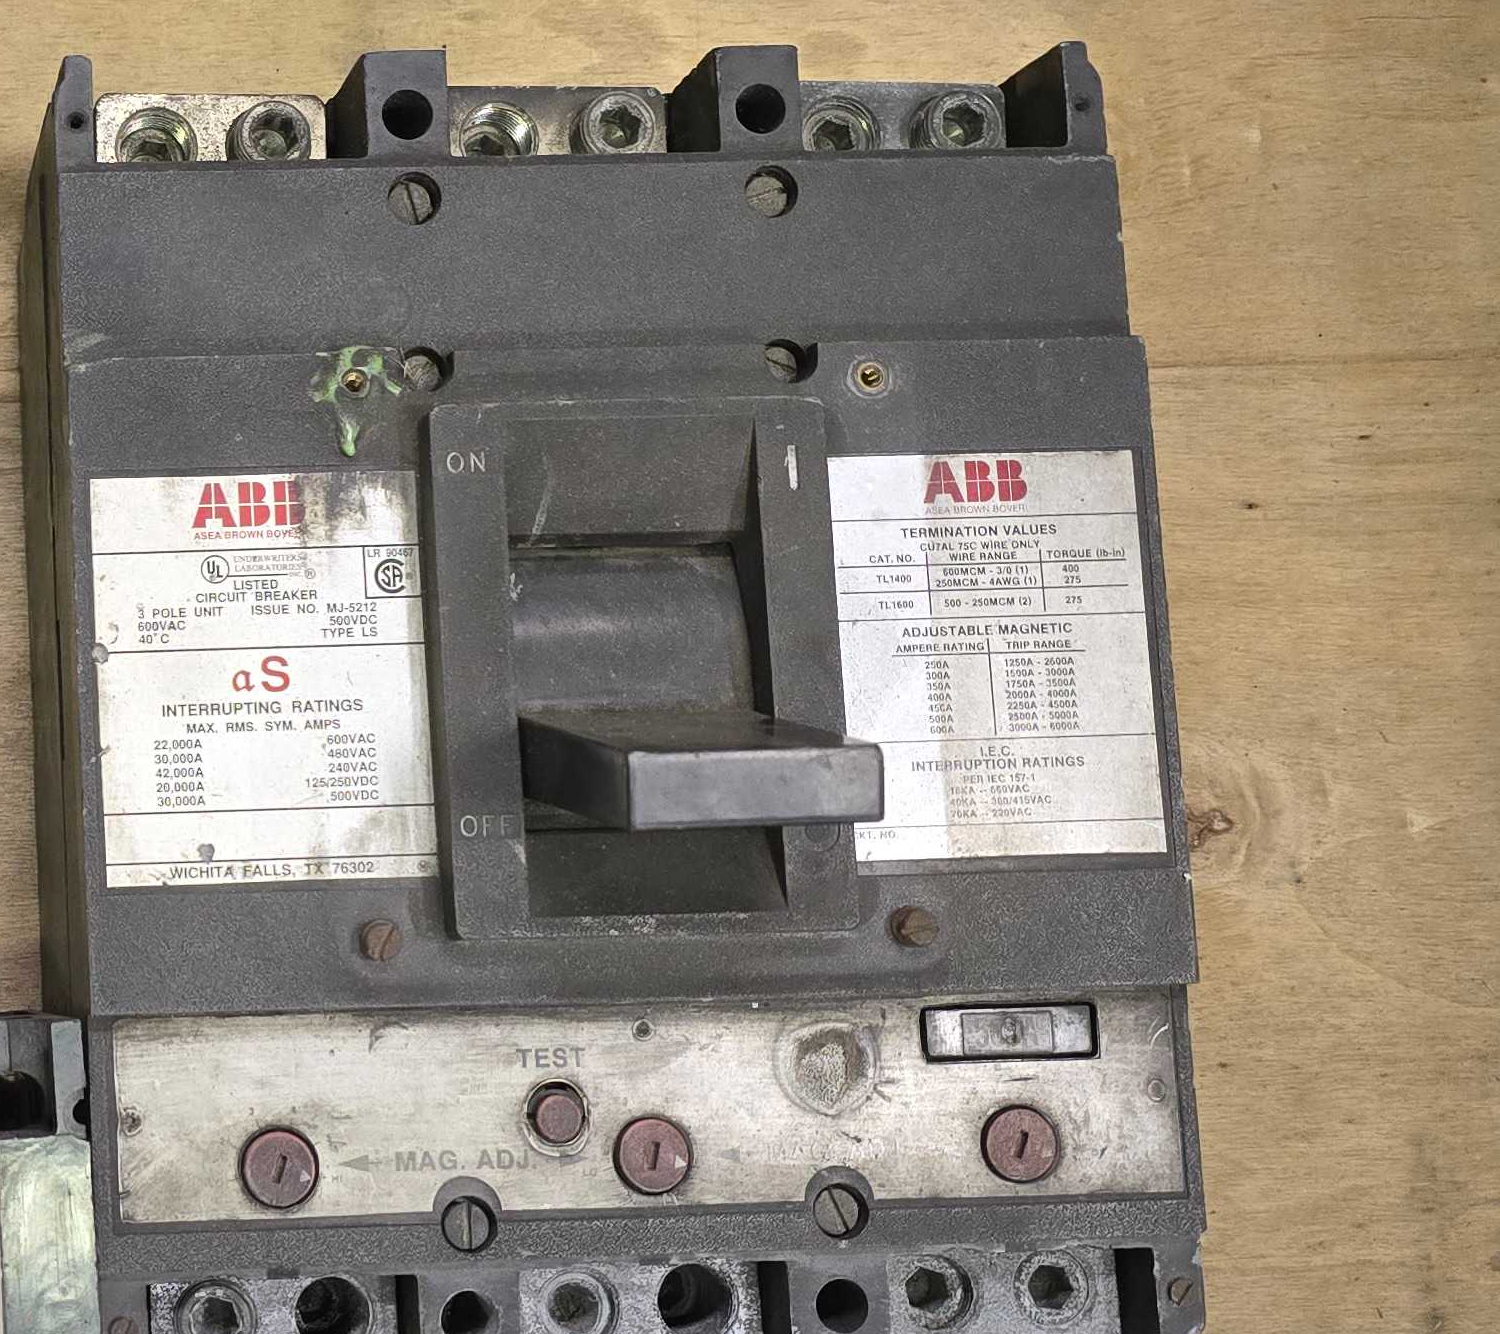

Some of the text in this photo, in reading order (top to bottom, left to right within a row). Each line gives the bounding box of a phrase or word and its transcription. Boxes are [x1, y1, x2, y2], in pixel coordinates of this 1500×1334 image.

[447, 452, 486, 473] ON
[923, 459, 1028, 504] ABB
[193, 530, 222, 541] ASEA
[224, 529, 265, 540] BROWN
[900, 524, 1057, 539] TERMINATION VALUES
[367, 549, 380, 558] LR
[869, 553, 916, 564] CAT. NO.
[949, 547, 1125, 562] WIRE RANGE TORQUE (lb-in)
[233, 579, 278, 591] LISTED
[195, 588, 317, 603] CIRCUIT BREAKER
[1064, 595, 1083, 605] 275
[136, 601, 377, 619] 3 POLE UNIT ISSUE NO. MJ-5212
[138, 614, 377, 632] 600VAC 500VDC
[902, 622, 1073, 638] ADJUSTABLE MAGNETIC
[160, 633, 169, 644] C
[320, 627, 355, 638] TYPE
[362, 626, 378, 637] LS
[1005, 639, 1072, 650] TRIP RANGE
[162, 698, 363, 717] INTERRUPTING RATINGS
[186, 719, 341, 733] MAX. RMS. SYM. AMPS
[154, 733, 376, 751] 22,000A 600VAC
[154, 747, 376, 765] 30,000A 480VAC
[911, 756, 1085, 772] INTERRUPTION RATINGS
[156, 761, 377, 779] 42,000A 240VAC
[156, 775, 379, 794] 20,000A 125/250VDC
[157, 789, 379, 808] 30,000A 500VDC
[460, 815, 520, 837] OFF
[169, 861, 375, 879] WICHITA FALLS, TX 76302
[515, 1047, 585, 1070] TEST
[394, 1149, 537, 1172] MAG. ADJ.
